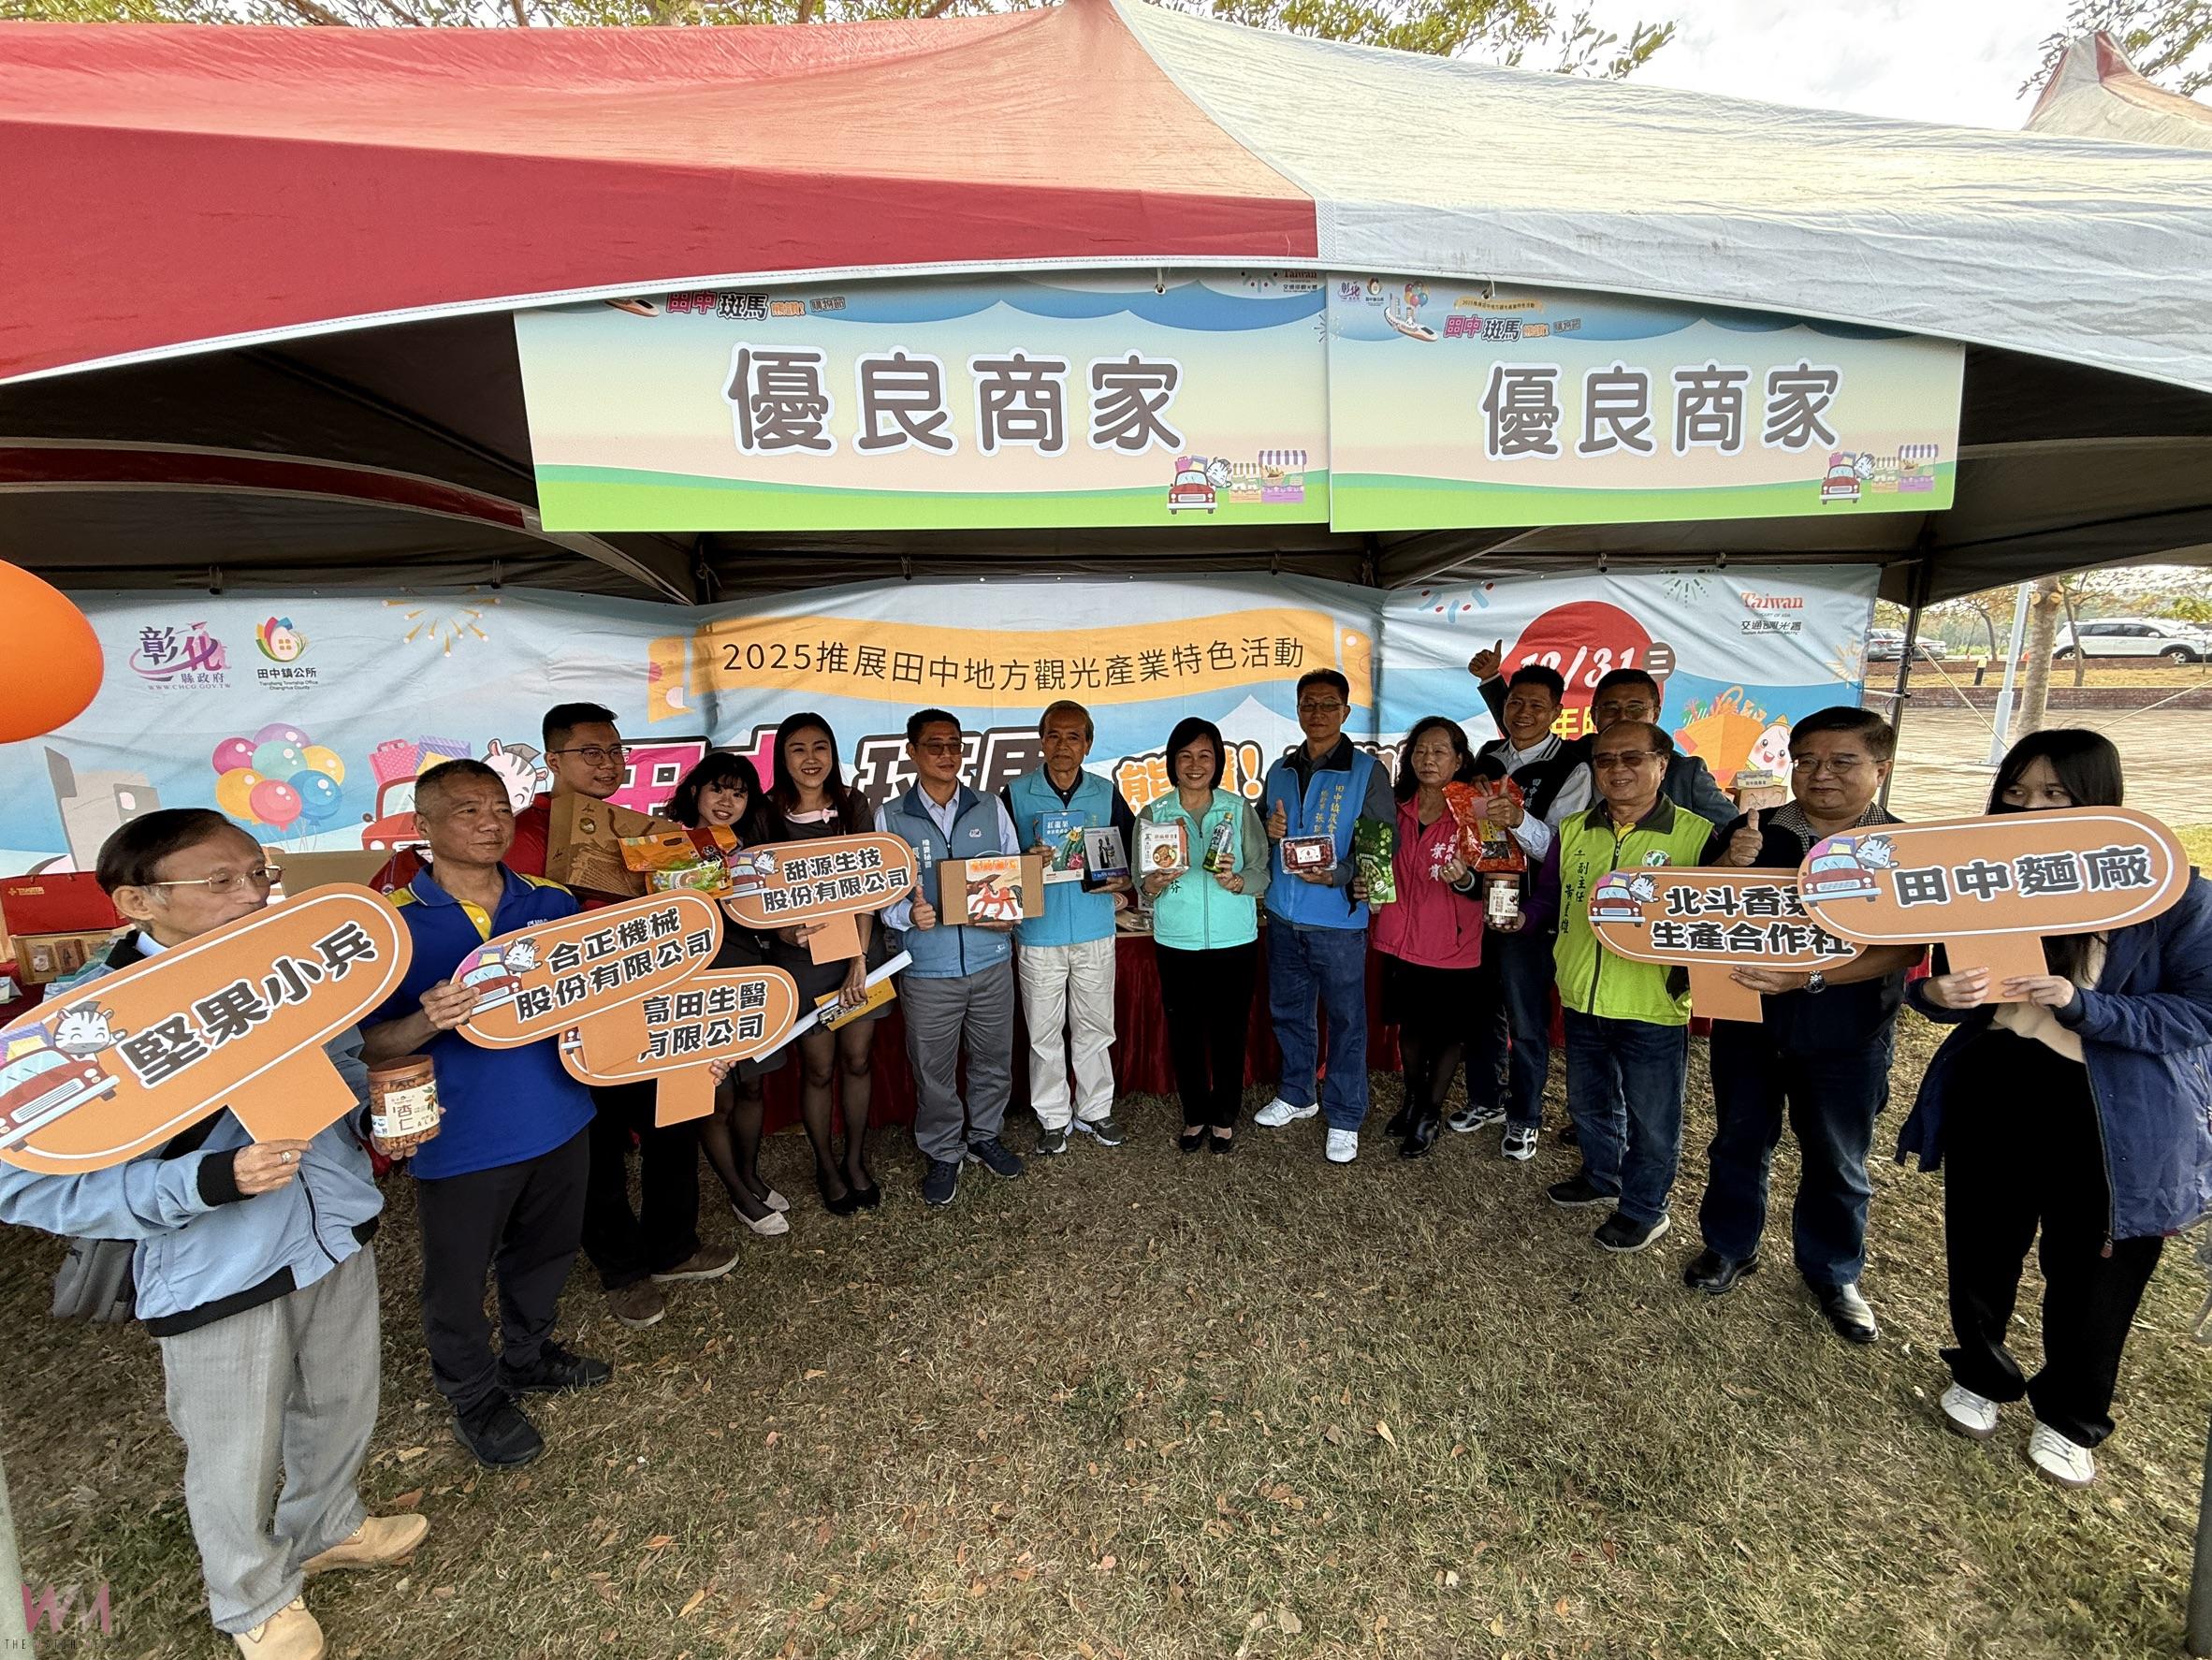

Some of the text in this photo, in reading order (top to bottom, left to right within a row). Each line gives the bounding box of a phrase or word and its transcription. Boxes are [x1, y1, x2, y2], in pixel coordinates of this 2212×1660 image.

[1444, 314, 1522, 342] 田中斑馬
[726, 346, 1183, 453] 優良商家
[1482, 362, 1841, 456] 優良商家
[1741, 592, 1803, 609] Taiwan
[139, 626, 222, 672] 彰化
[722, 635, 1304, 692] 2025推展田中地方觀光產業特色活動
[181, 673, 225, 684] 縣政府
[257, 667, 317, 679] 田中鎮公所
[784, 847, 882, 884] 甜源生技
[1576, 861, 1590, 903] 副主任
[1896, 845, 2156, 909] 田中麵廠
[762, 866, 910, 915] 股份有限公司
[546, 907, 682, 974] 合正機械
[1652, 923, 1855, 955] 生產合作社
[517, 928, 714, 1023] 股份有限公司
[117, 922, 378, 1088] 堅果小兵
[642, 982, 766, 1025] 高田生醫
